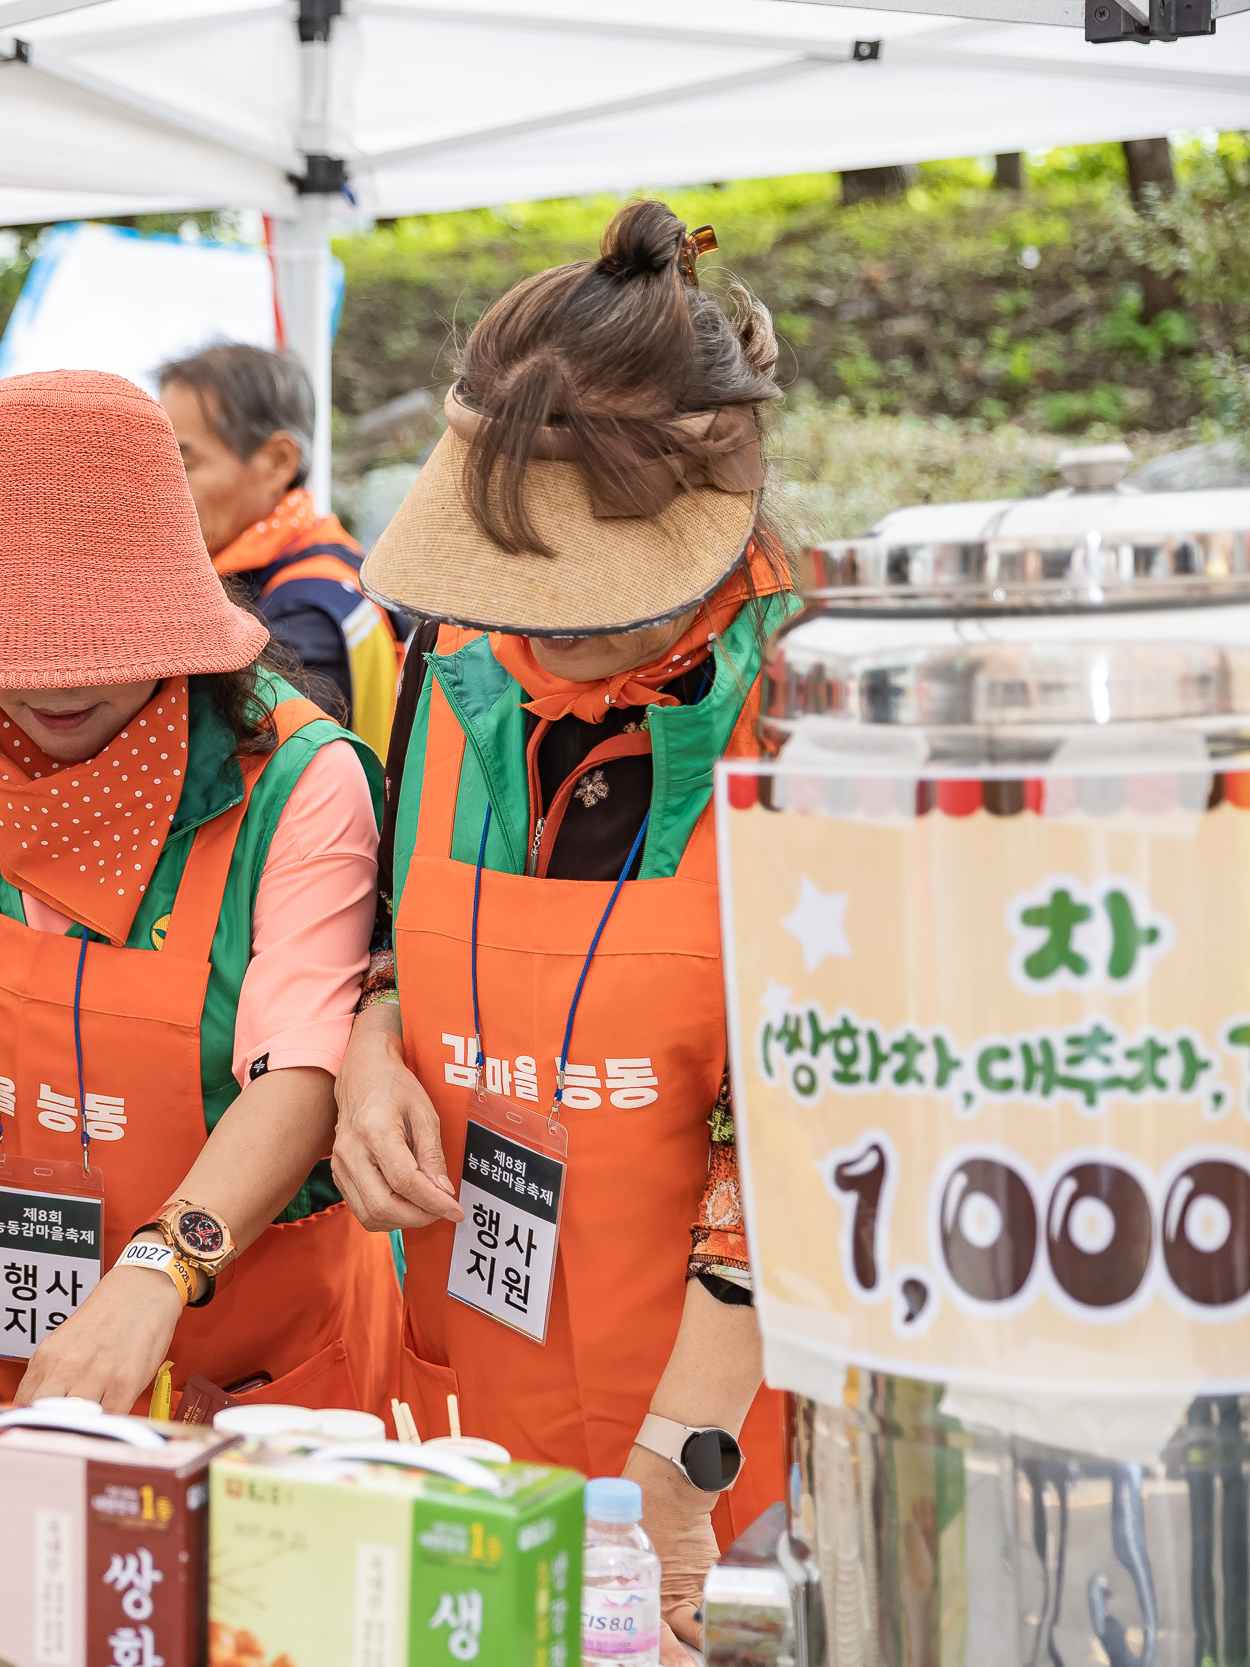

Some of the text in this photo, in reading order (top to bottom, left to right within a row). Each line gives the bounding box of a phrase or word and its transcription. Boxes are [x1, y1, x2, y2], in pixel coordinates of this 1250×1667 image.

[1019, 886, 1160, 982] 차
[554, 1056, 659, 1110] 능동
[761, 1008, 1250, 1108] (쌍화차,대추차,
[36, 1083, 128, 1142] 능동
[467, 1152, 553, 1207] 능동감마을축제
[494, 1147, 527, 1177] 제8회
[22, 1205, 63, 1226] 제8회
[472, 1202, 538, 1268] 행사
[126, 1245, 171, 1262] 0027
[466, 1248, 531, 1315] 지원
[3, 1261, 85, 1307] 행사
[429, 1587, 484, 1661] 생
